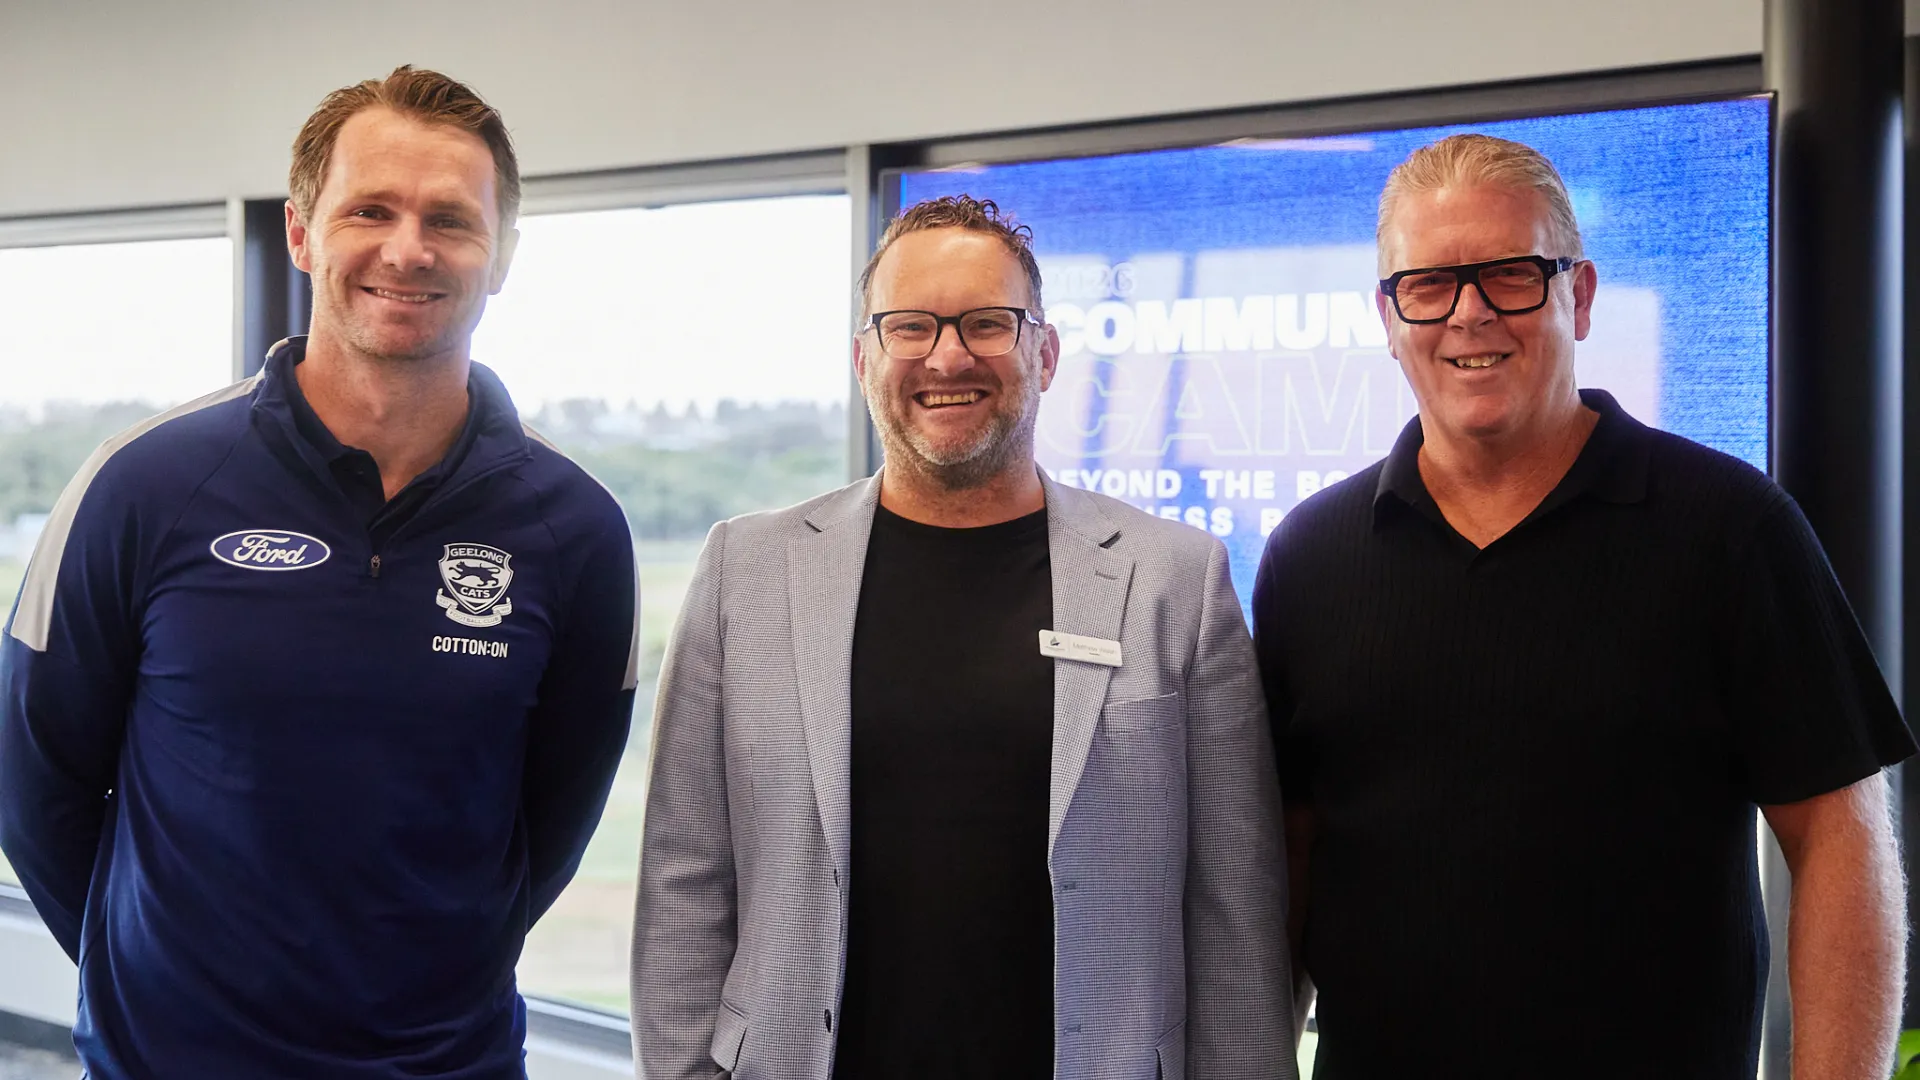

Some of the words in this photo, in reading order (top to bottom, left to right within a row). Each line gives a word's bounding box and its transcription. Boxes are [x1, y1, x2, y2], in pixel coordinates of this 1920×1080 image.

[1046, 291, 1388, 355] COMMUN
[1041, 350, 1402, 457] CAM
[1199, 469, 1275, 499] THE
[233, 534, 308, 564] Ford
[450, 547, 504, 564] GEELONG
[460, 587, 491, 598] CATS
[432, 636, 509, 658] COTTON:ON
